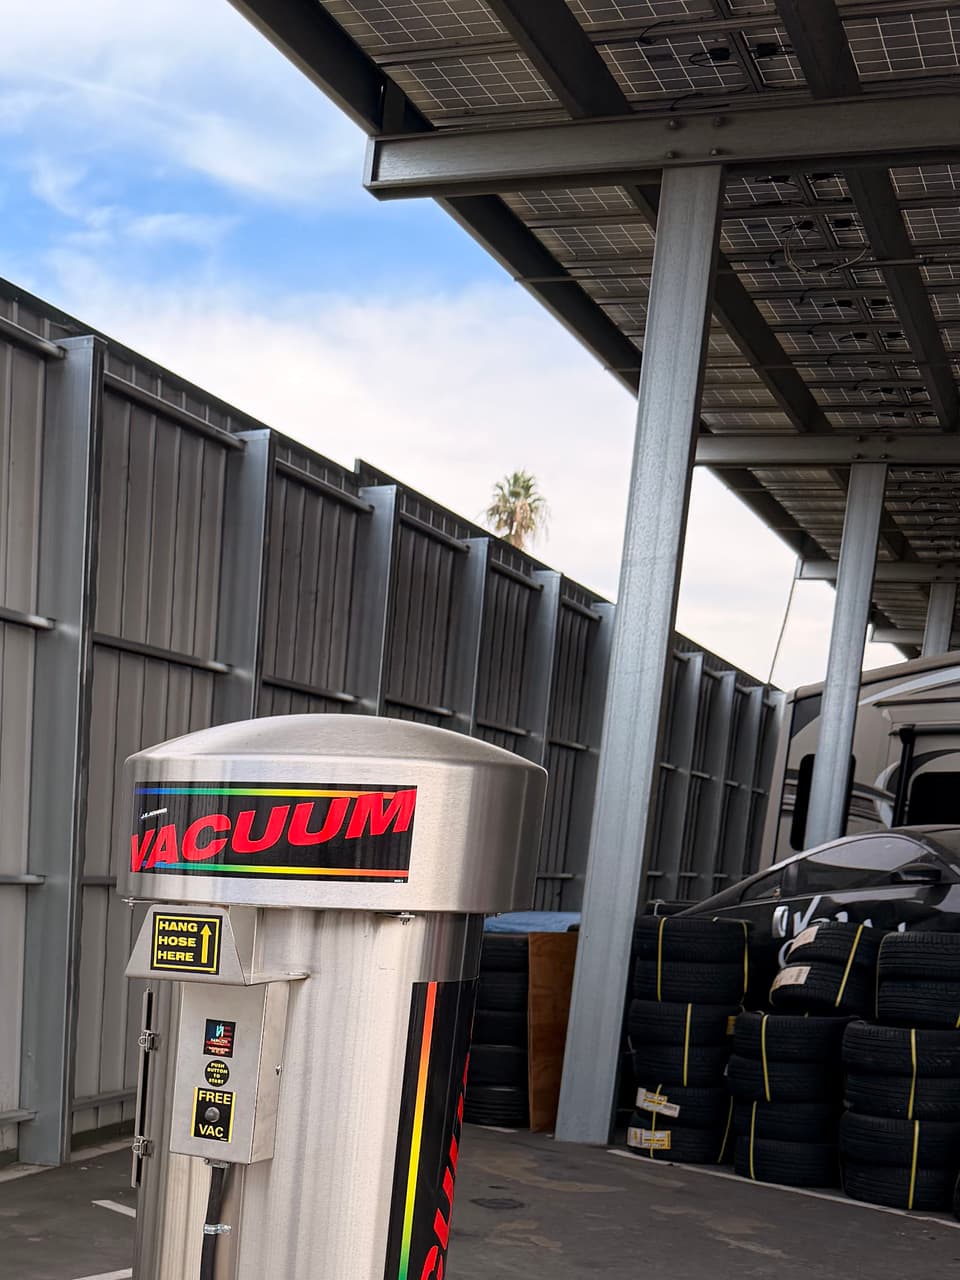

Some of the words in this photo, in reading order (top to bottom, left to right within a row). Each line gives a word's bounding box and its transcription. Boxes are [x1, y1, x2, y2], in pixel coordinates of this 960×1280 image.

[130, 789, 417, 873] VACUUM
[159, 921, 198, 932] HANG
[158, 936, 197, 947] HOSE
[157, 951, 194, 962] HERE
[199, 1090, 231, 1105] FREE
[199, 1123, 224, 1138] VAC
